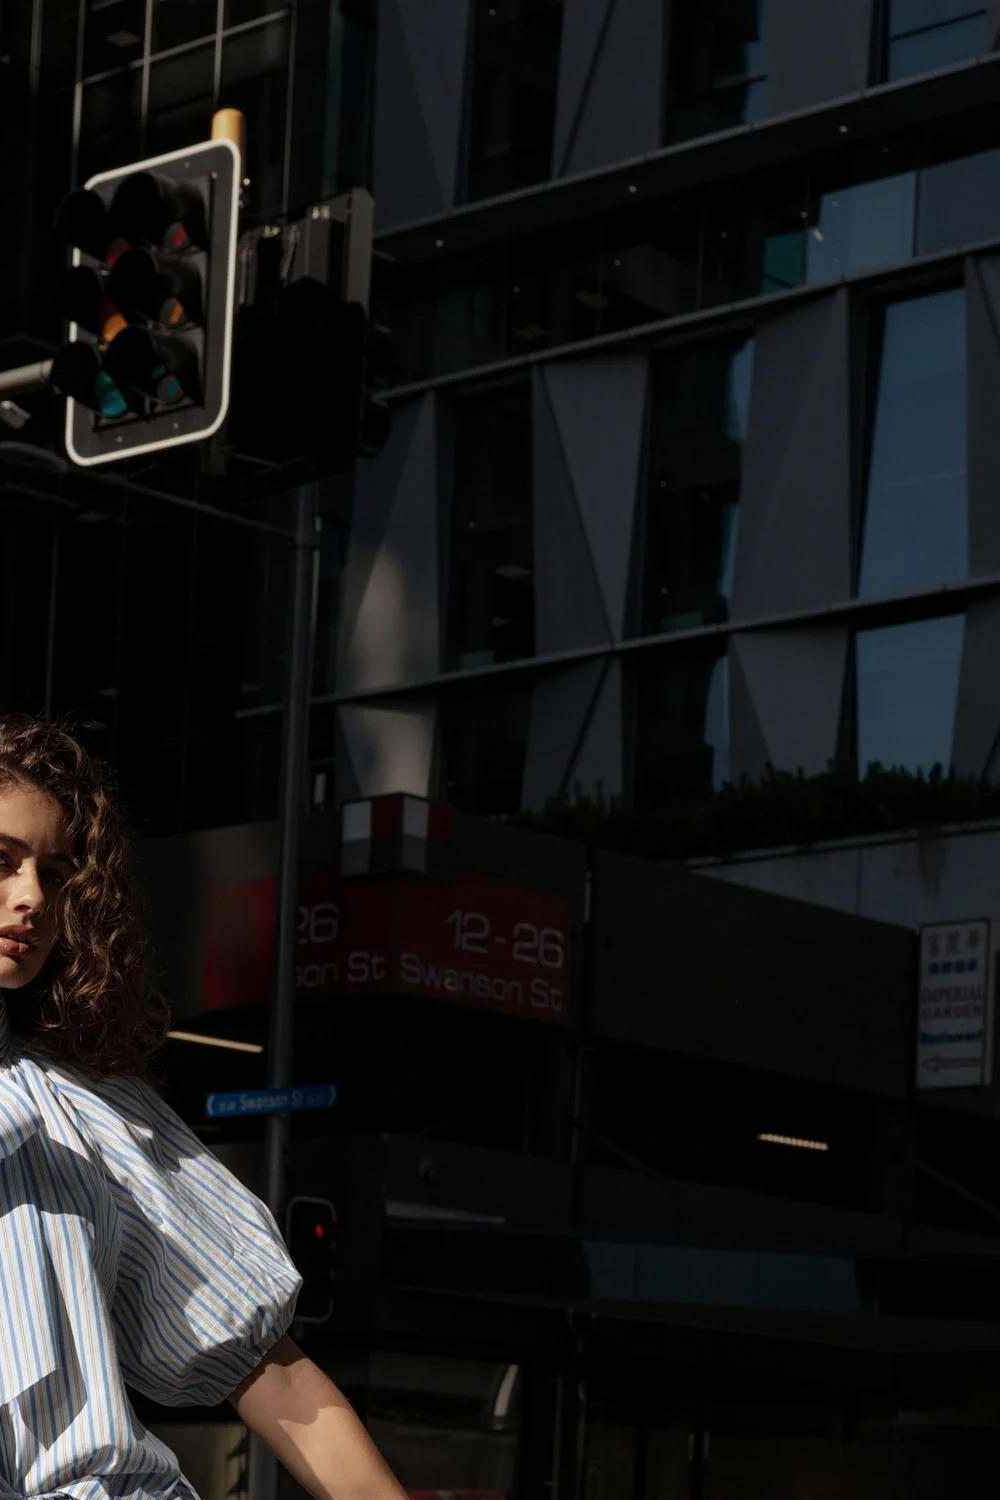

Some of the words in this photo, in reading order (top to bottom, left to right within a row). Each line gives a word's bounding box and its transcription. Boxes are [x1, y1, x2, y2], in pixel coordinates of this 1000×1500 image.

[347, 950, 386, 983] St
[446, 910, 565, 969] 12-26
[399, 952, 523, 1004] Swanson
[530, 977, 563, 1012] St
